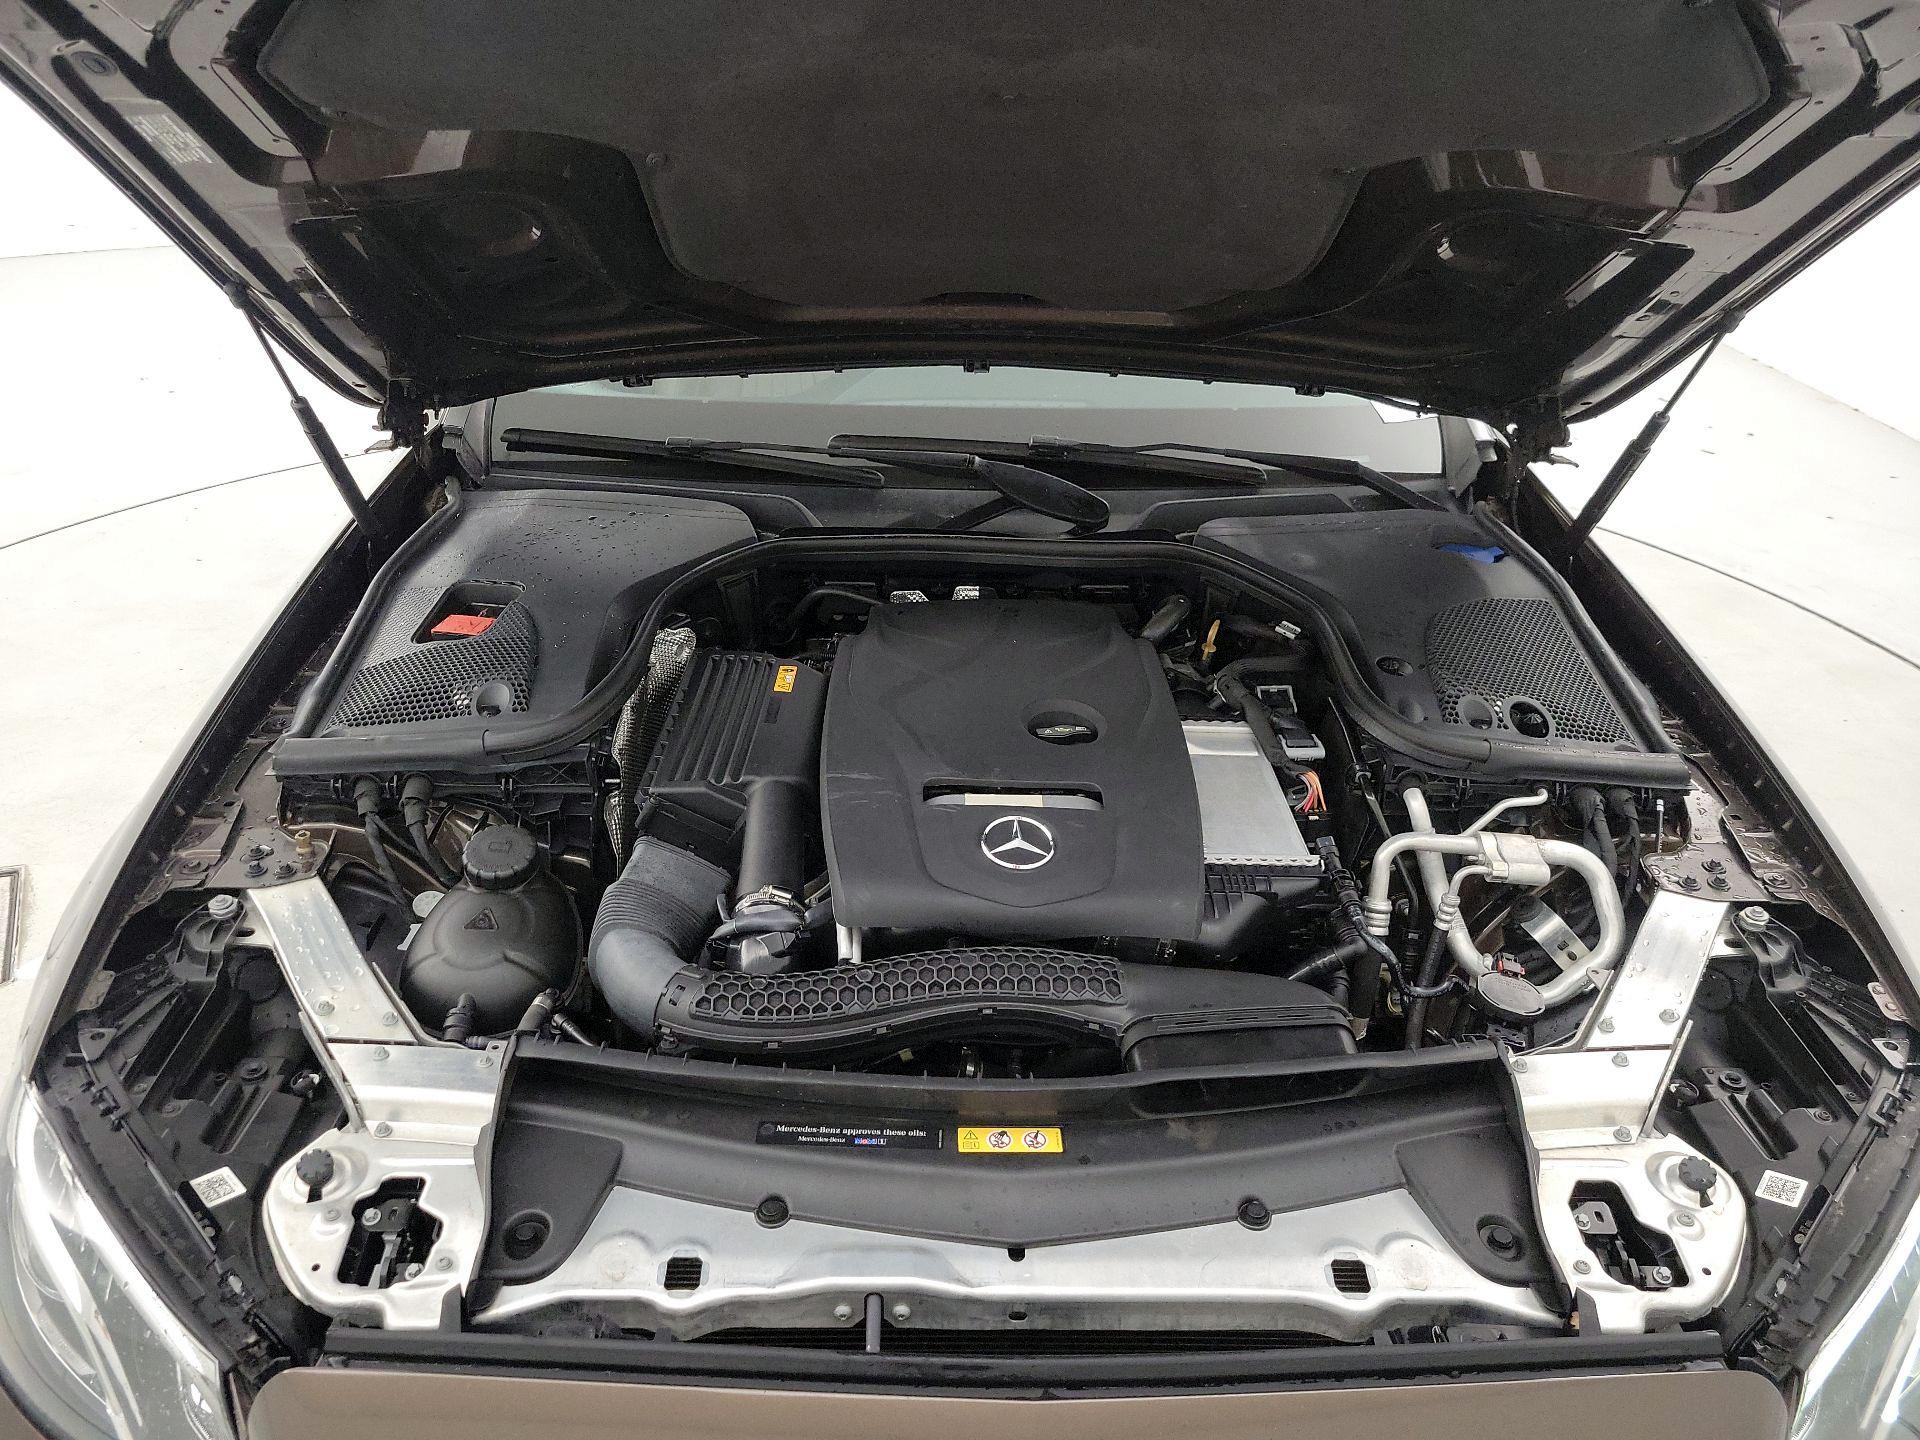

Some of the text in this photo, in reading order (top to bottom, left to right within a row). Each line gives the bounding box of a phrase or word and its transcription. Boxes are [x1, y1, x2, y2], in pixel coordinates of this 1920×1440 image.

[775, 1124, 841, 1134] Mercedes-Benz
[842, 1127, 881, 1136] approves
[883, 1128, 907, 1136] these
